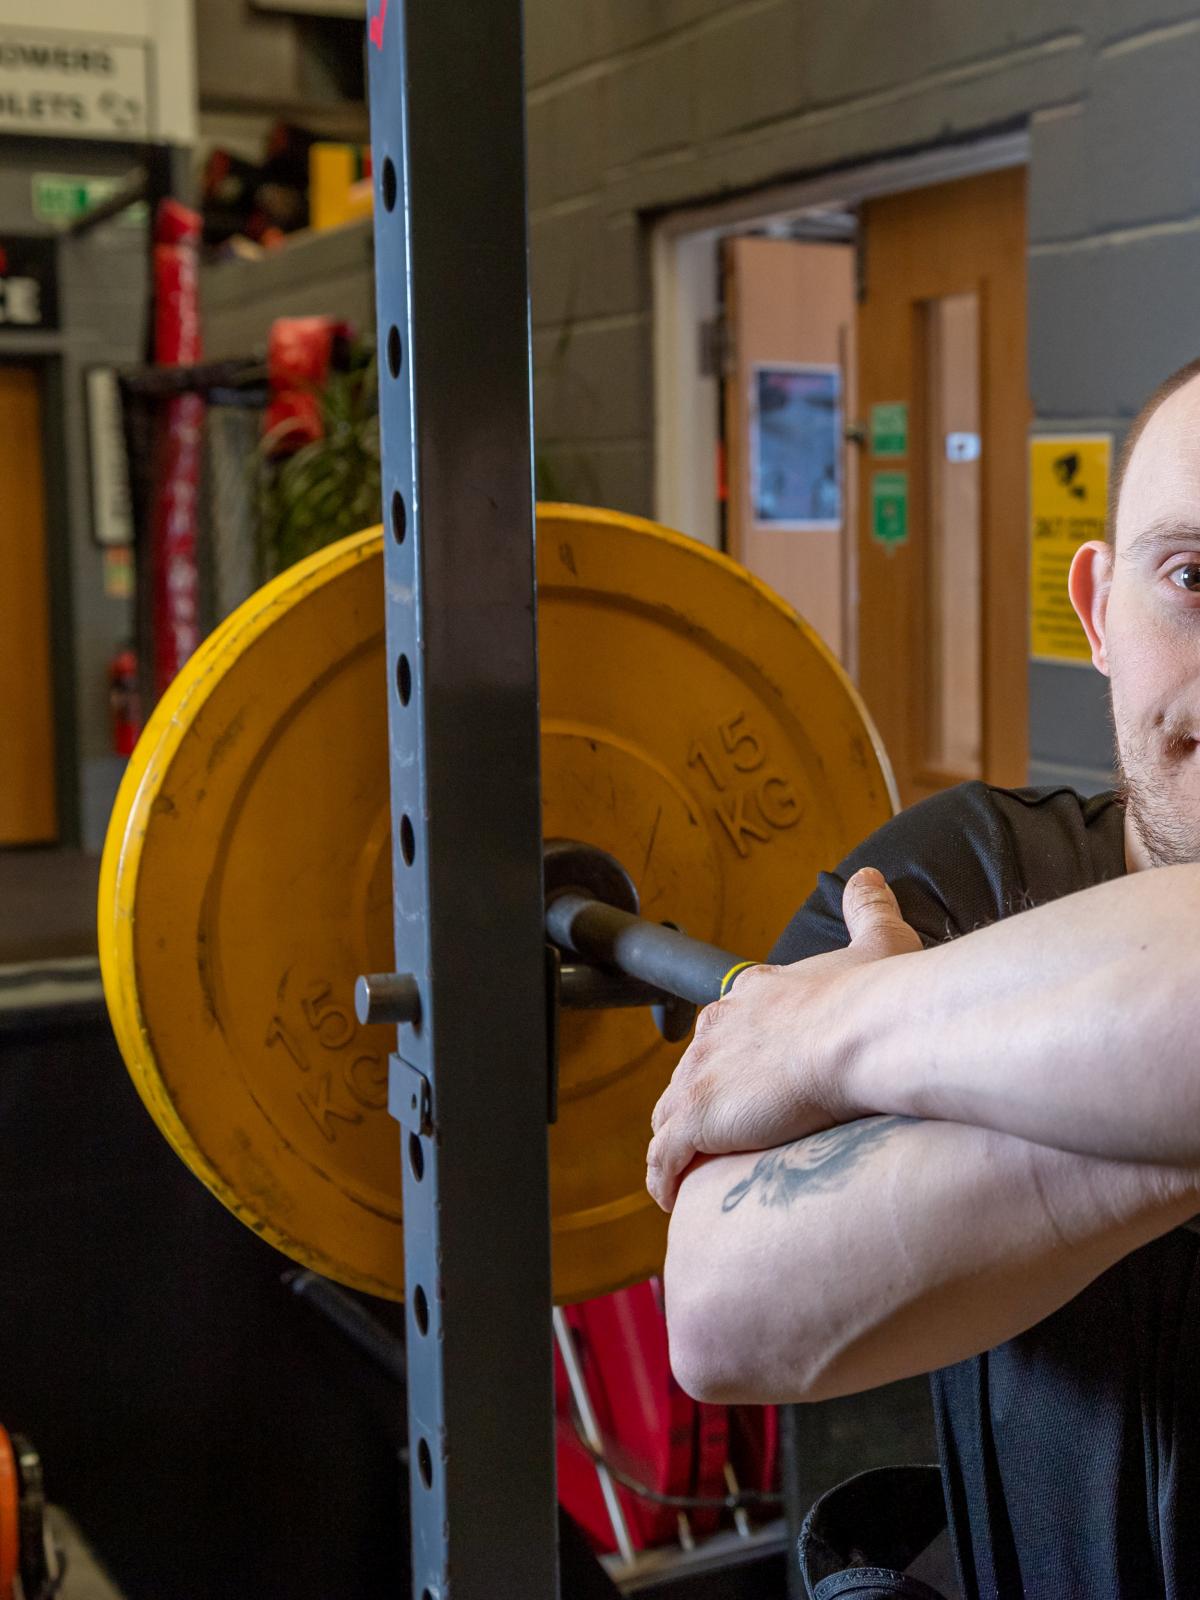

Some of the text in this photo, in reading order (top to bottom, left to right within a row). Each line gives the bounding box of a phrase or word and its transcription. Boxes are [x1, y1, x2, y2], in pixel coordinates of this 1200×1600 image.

[687, 711, 767, 792] 15
[714, 777, 804, 859] KG
[264, 979, 357, 1072] 15
